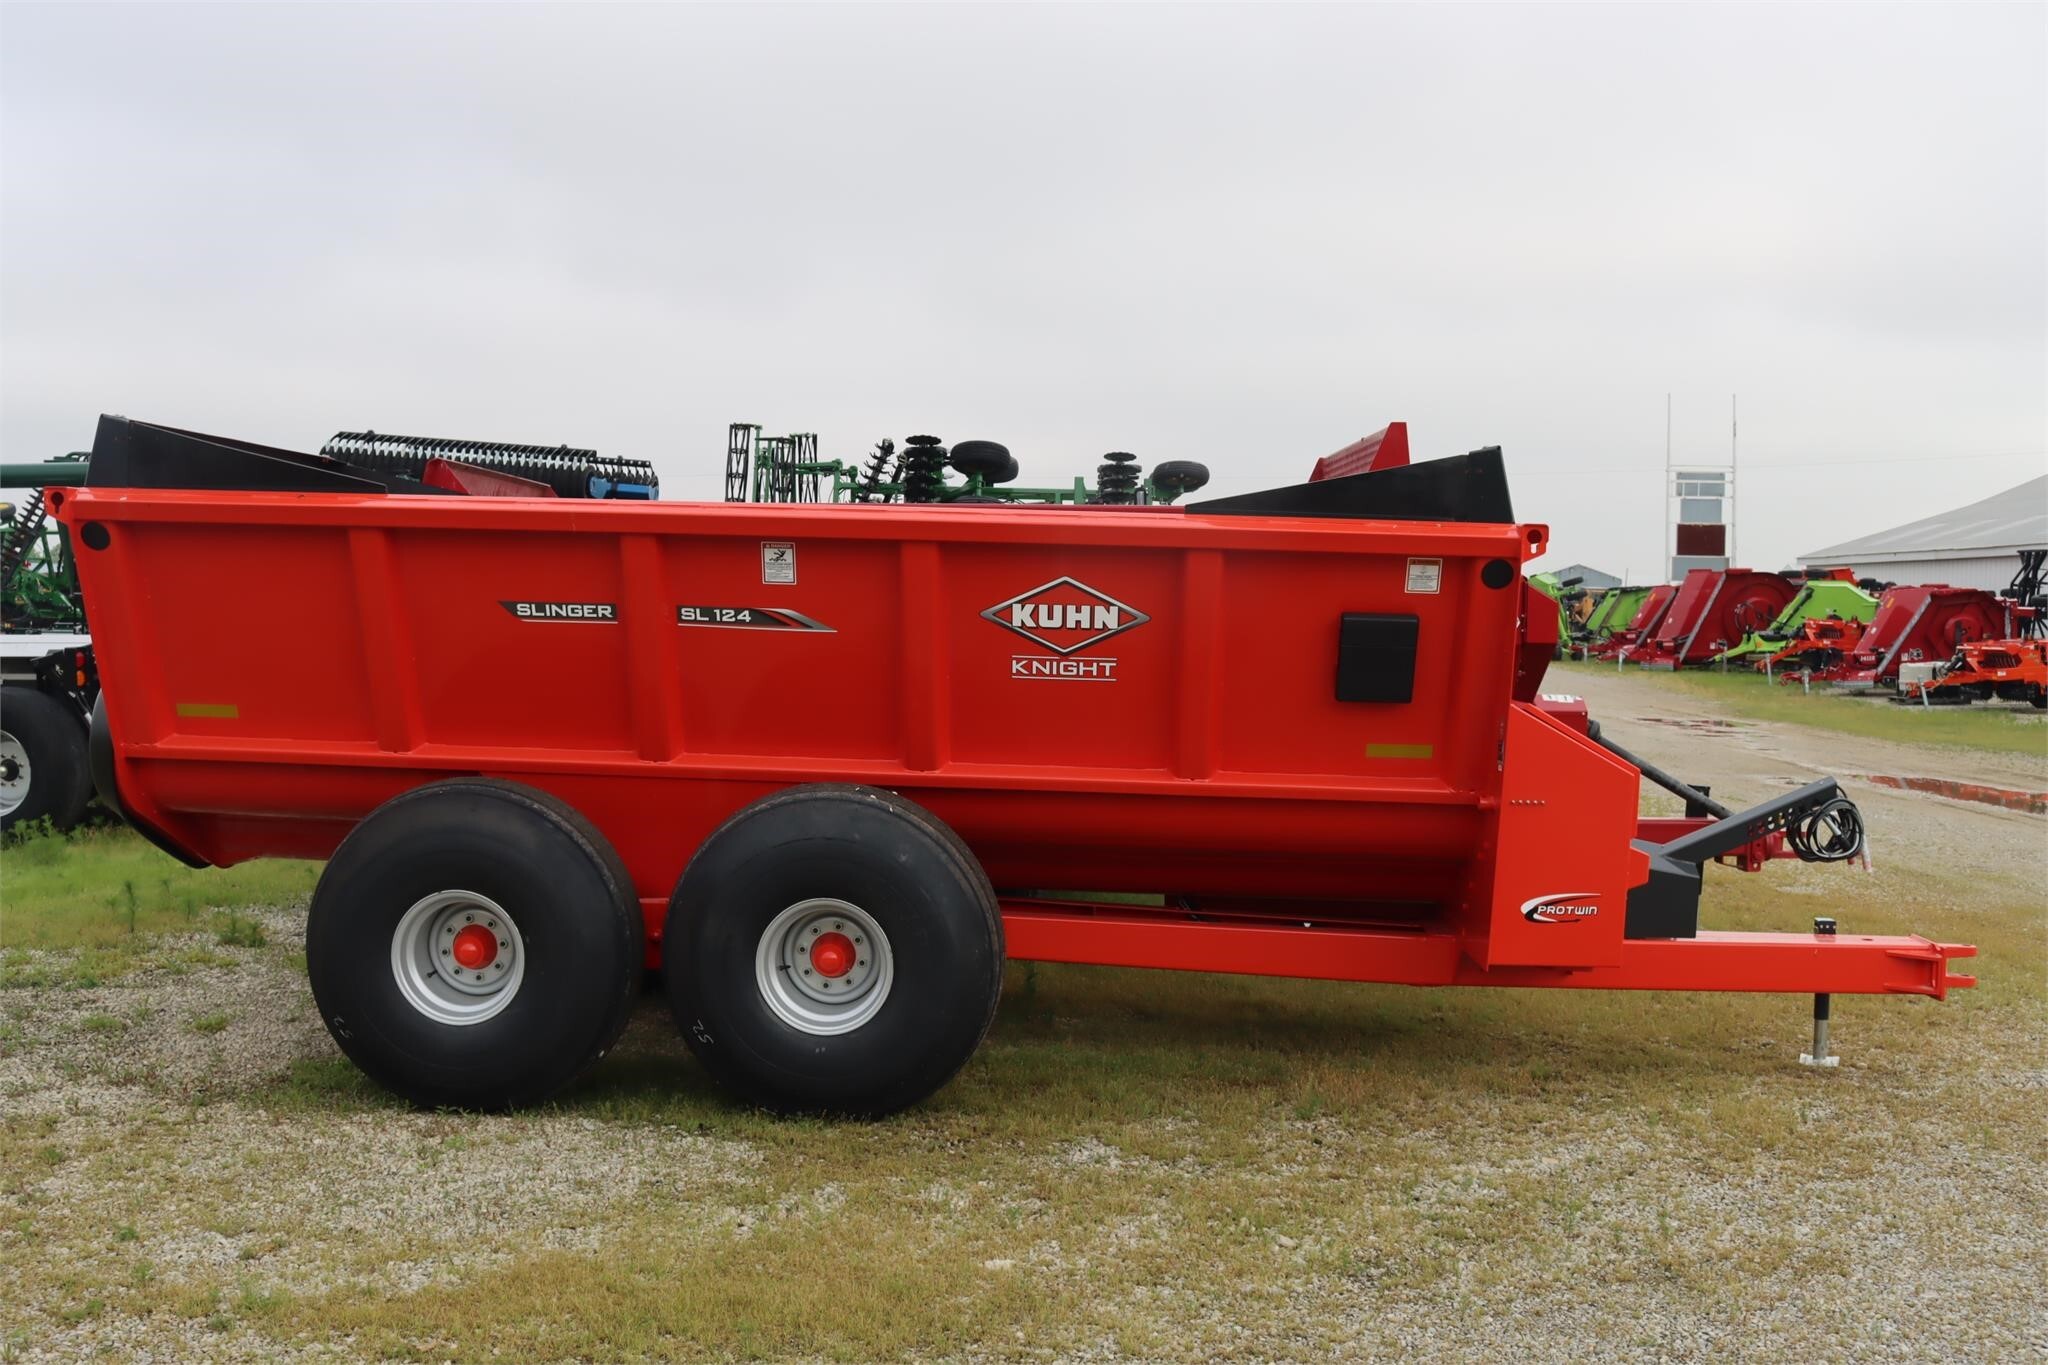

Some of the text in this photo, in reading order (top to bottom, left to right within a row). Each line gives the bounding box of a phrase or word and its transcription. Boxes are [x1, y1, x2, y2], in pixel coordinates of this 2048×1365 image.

[516, 603, 613, 619] SLINGER
[680, 607, 751, 623] SL 124
[1011, 603, 1119, 630] KUHN
[1011, 659, 1117, 677] KNIGHT
[1537, 905, 1598, 915] PROTWIN
